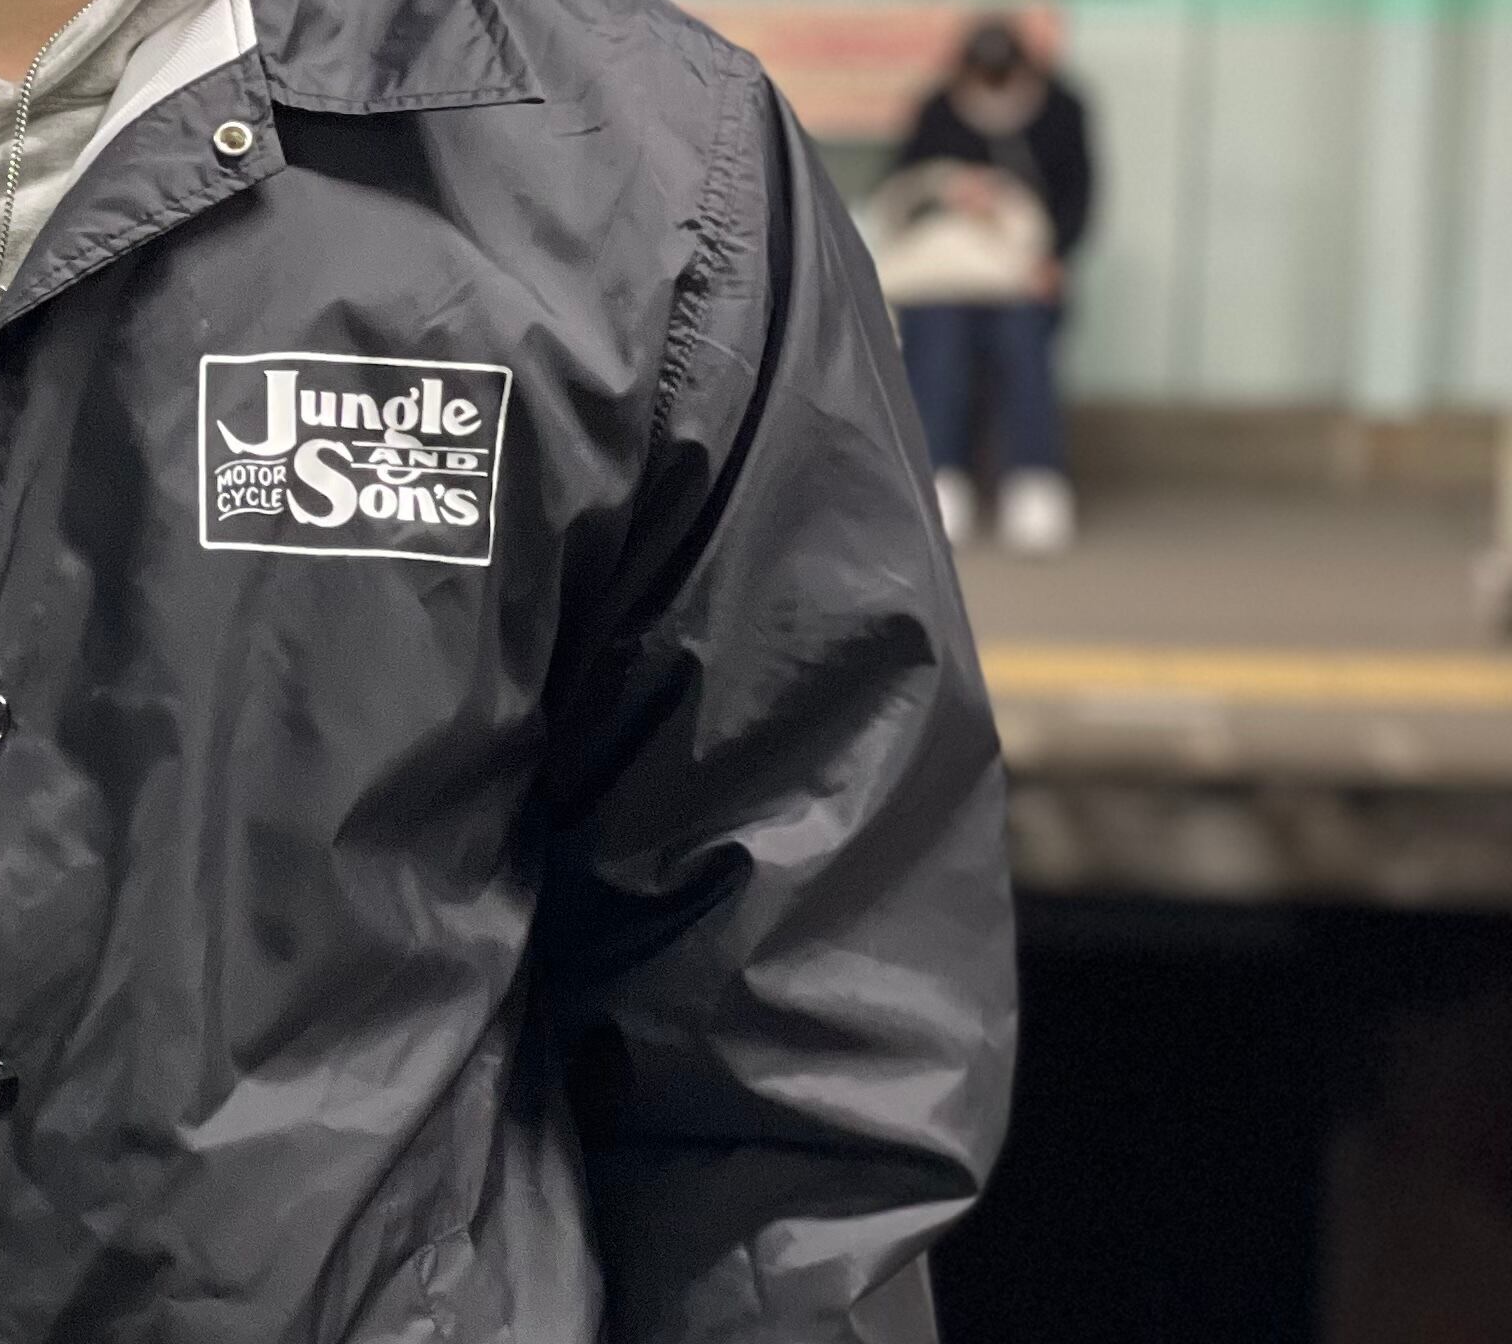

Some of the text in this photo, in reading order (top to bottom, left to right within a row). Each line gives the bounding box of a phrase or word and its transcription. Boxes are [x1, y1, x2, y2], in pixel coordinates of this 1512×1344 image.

[216, 370, 482, 458] Jungle
[368, 447, 479, 471] AND
[216, 464, 288, 494] MOTOR
[287, 438, 480, 528] Son's
[217, 487, 283, 514] CYCLE
